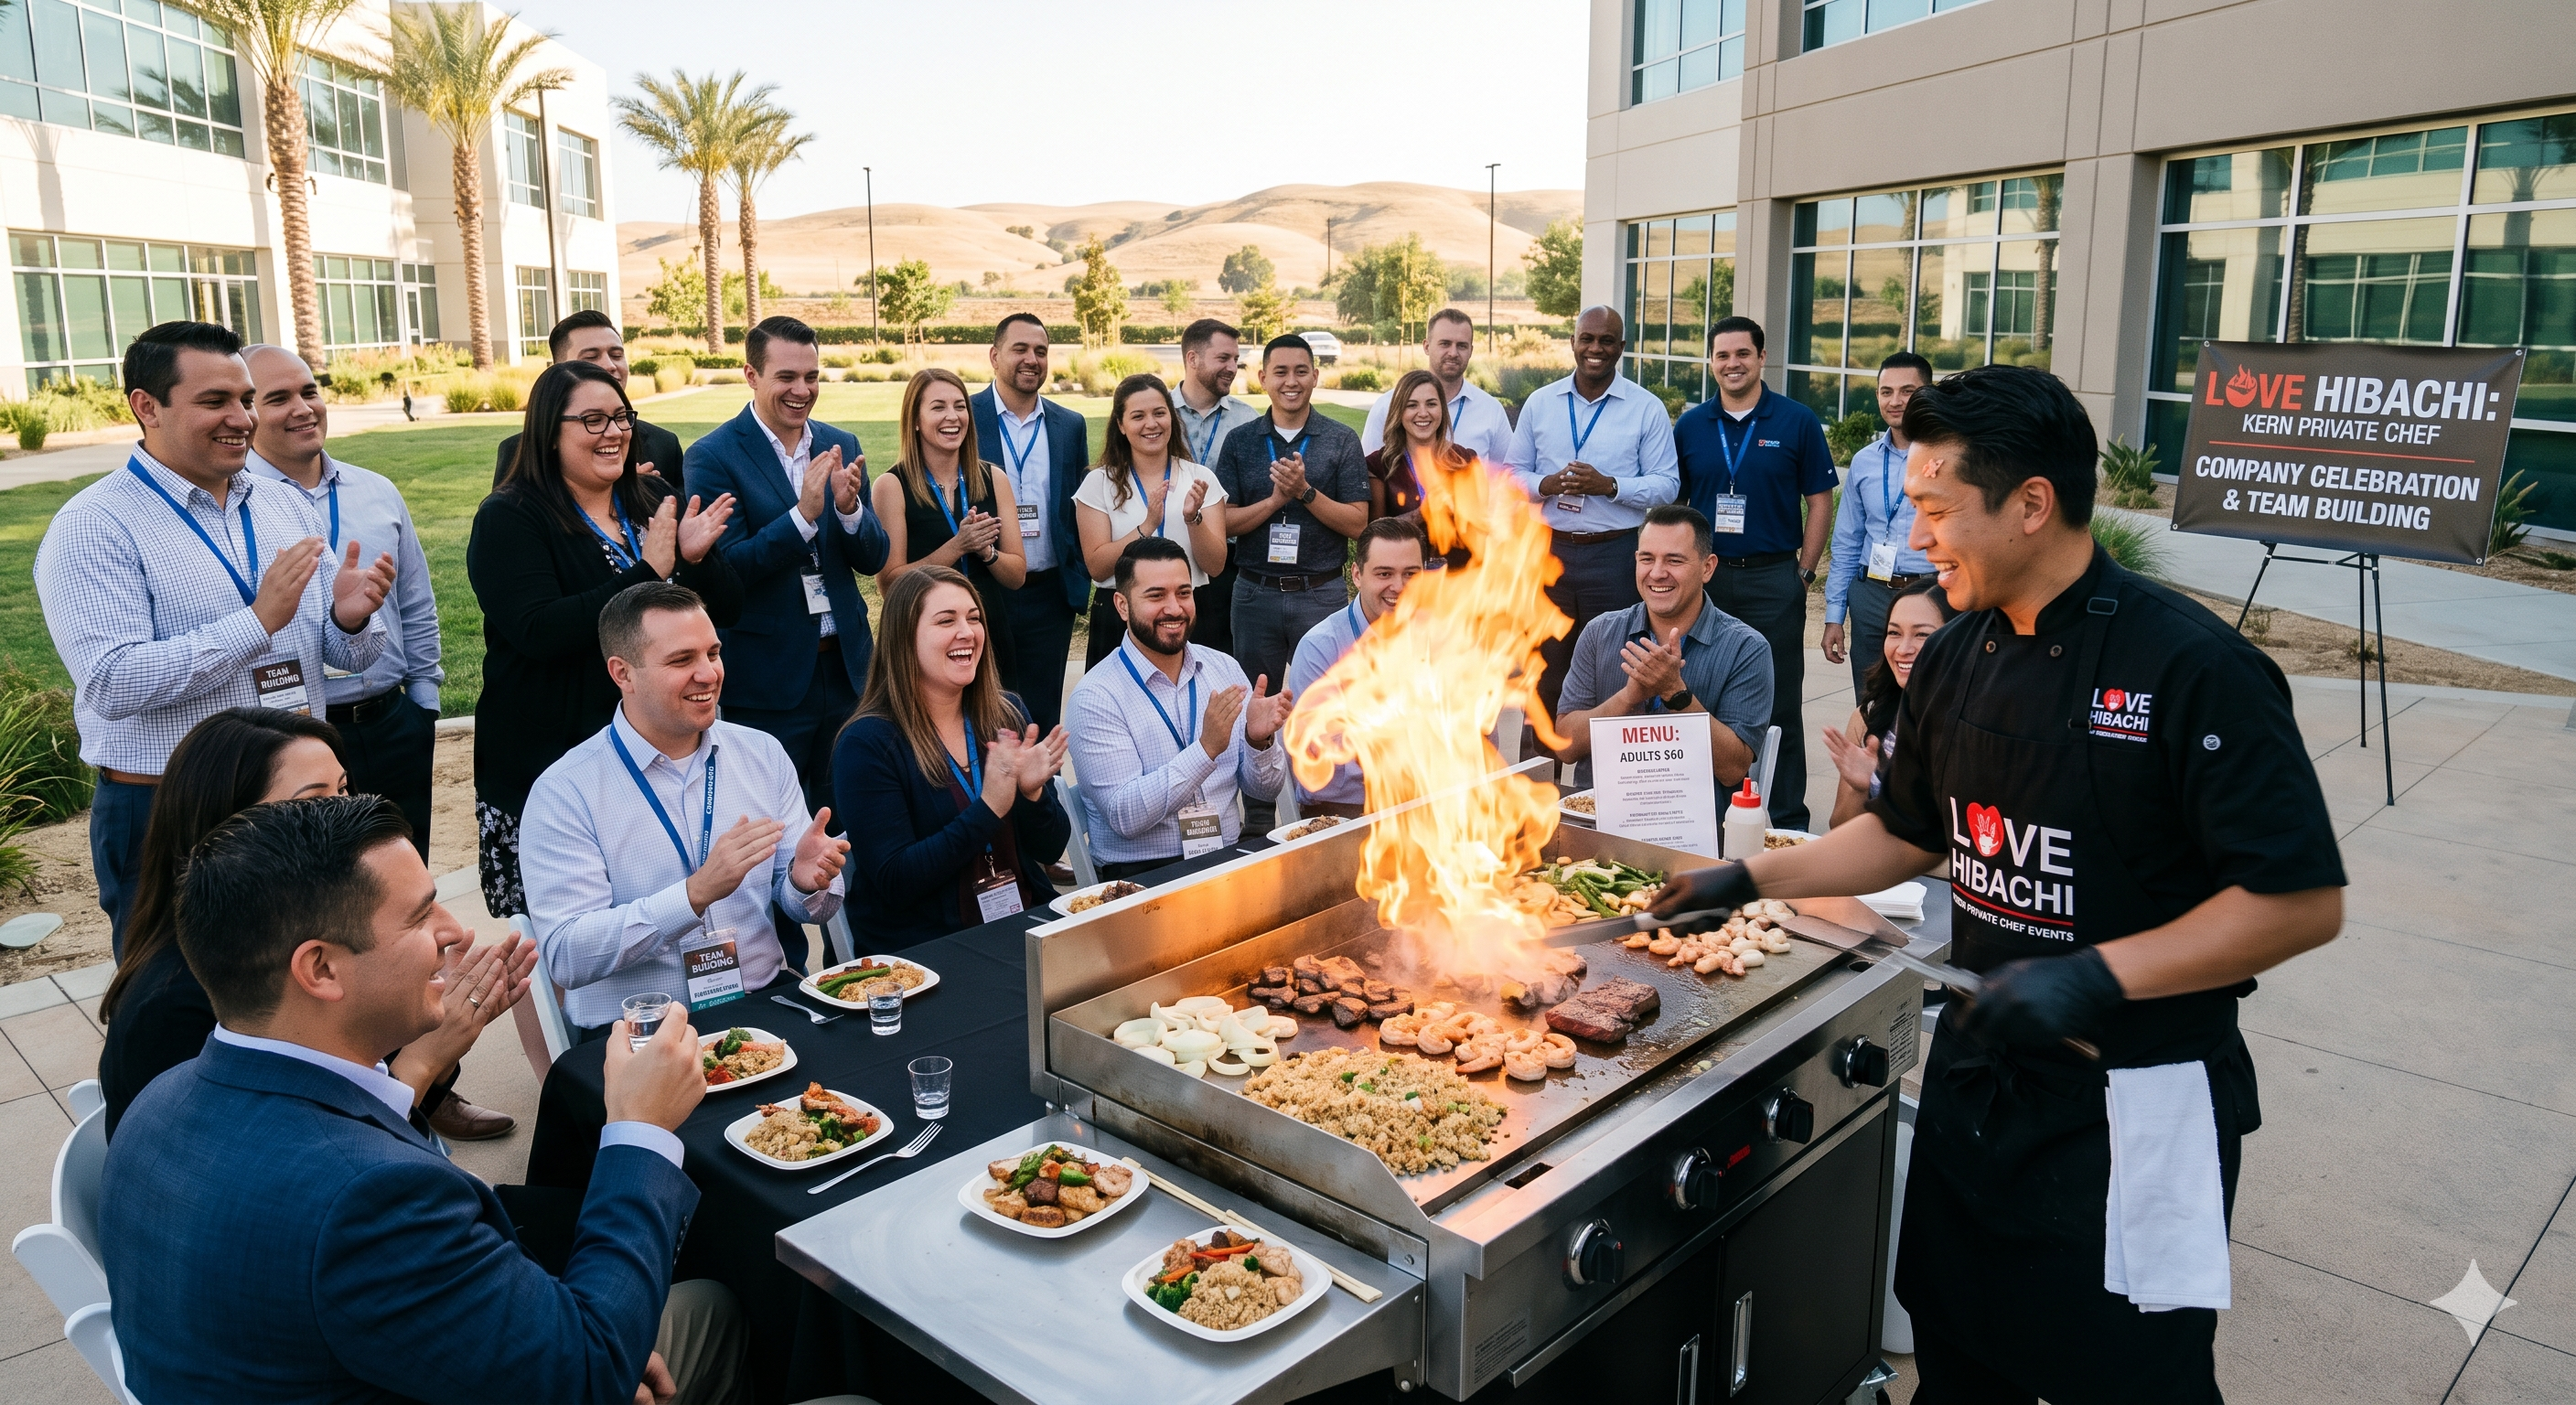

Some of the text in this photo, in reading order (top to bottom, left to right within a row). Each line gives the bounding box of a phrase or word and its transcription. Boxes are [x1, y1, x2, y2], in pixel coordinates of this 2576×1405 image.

[2314, 375, 2500, 422] HIBACHI:
[2242, 413, 2442, 445] KERN PRIVATE CHEF
[2195, 456, 2480, 501] COMPANY CELEBRATION
[2222, 488, 2431, 531] & TEAM BUILDING
[1622, 725, 1680, 744] MENU:
[2089, 710, 2149, 732] HIBACHI
[1619, 748, 1684, 763] ADULTS $60
[1951, 847, 2074, 916] HIBACHI
[1967, 904, 2075, 942] PRIVATE CHEF EVENTS
[699, 949, 724, 962] TEAM
